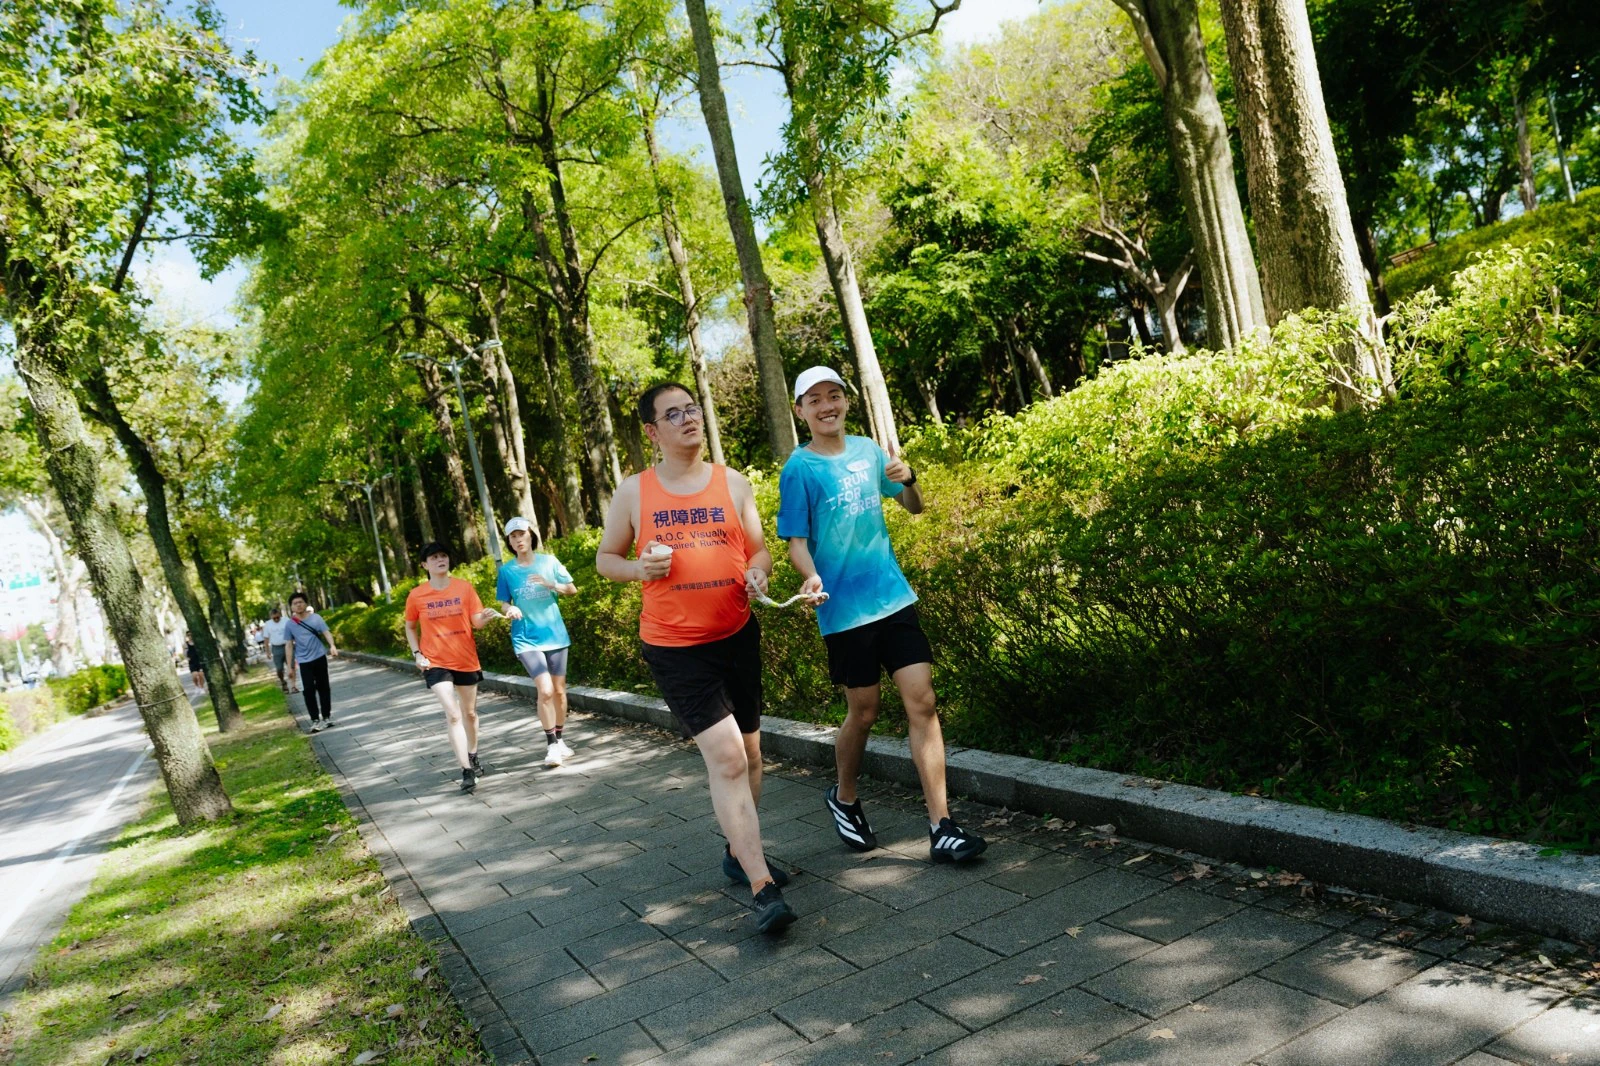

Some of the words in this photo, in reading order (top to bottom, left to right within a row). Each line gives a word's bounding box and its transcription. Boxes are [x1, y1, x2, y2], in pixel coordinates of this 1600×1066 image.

[843, 471, 869, 489] RUN
[837, 487, 861, 506] FOR
[653, 507, 725, 528] 視障跑者
[655, 531, 684, 543] R.O.C
[690, 529, 728, 539] Visually
